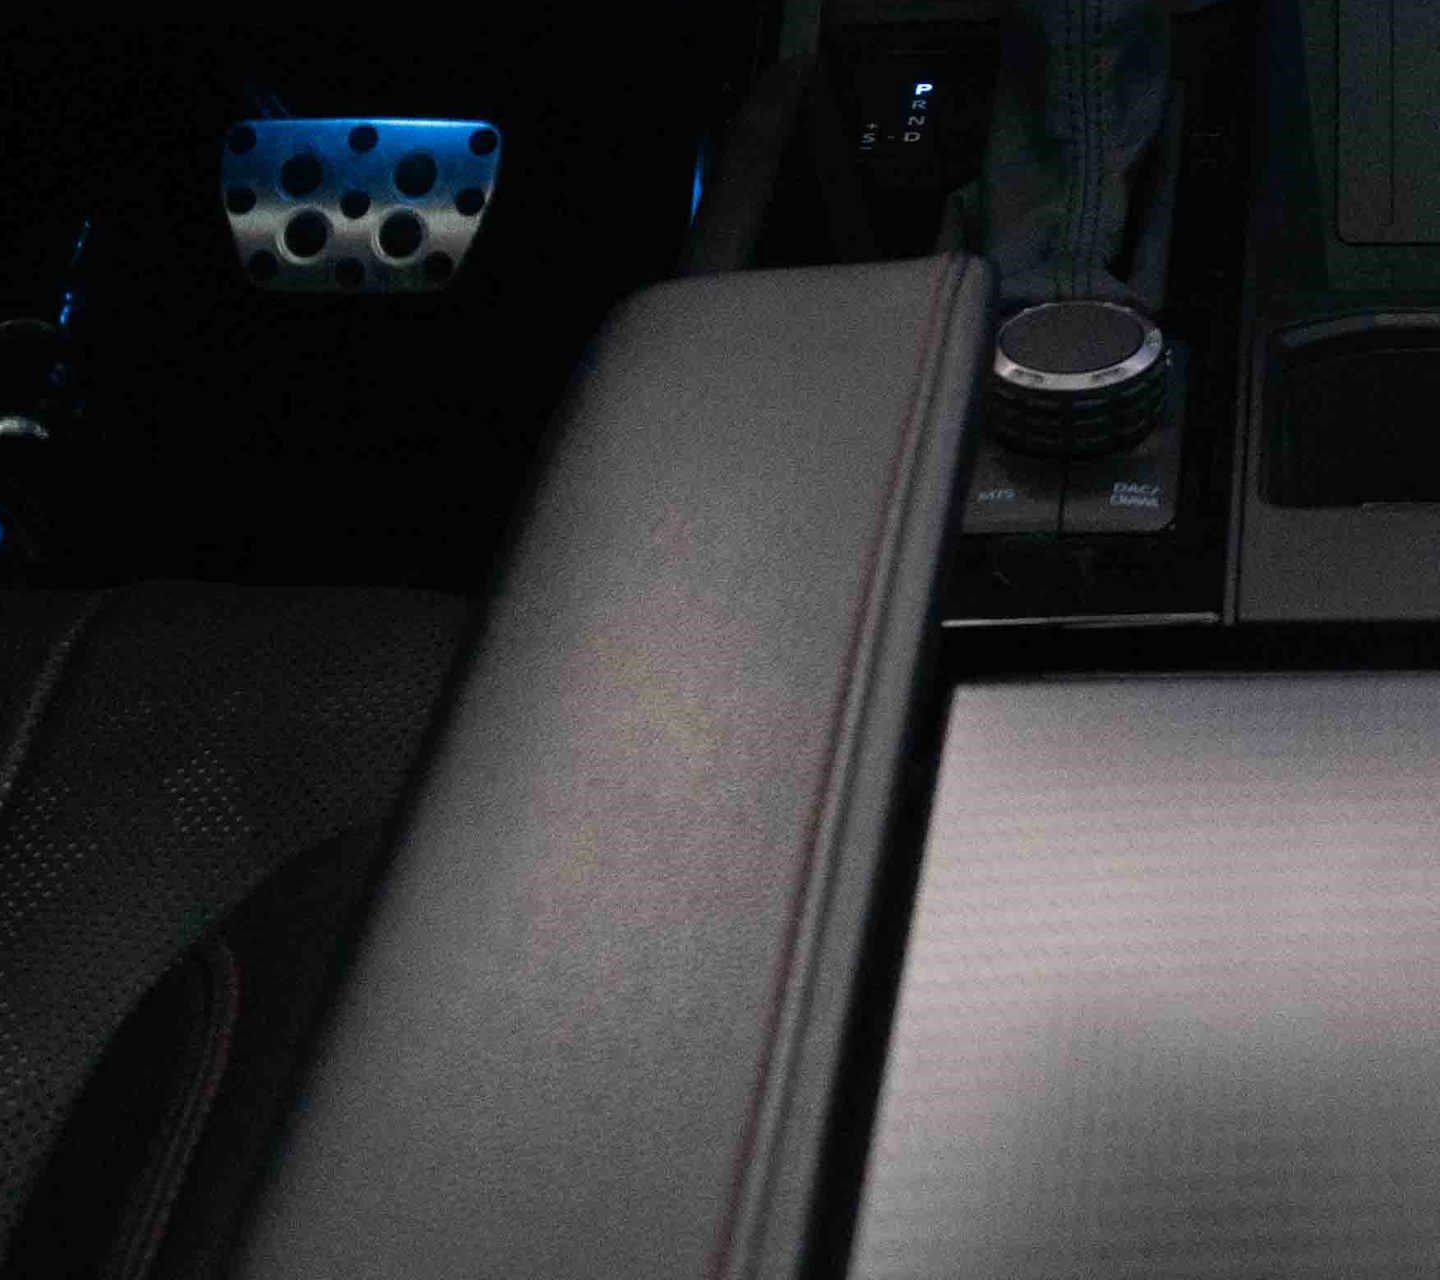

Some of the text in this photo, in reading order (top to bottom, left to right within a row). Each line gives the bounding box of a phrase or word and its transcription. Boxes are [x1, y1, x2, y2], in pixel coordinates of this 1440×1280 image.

[914, 82, 934, 96] P
[911, 99, 928, 111] R
[907, 115, 926, 127] N
[903, 131, 922, 144] D
